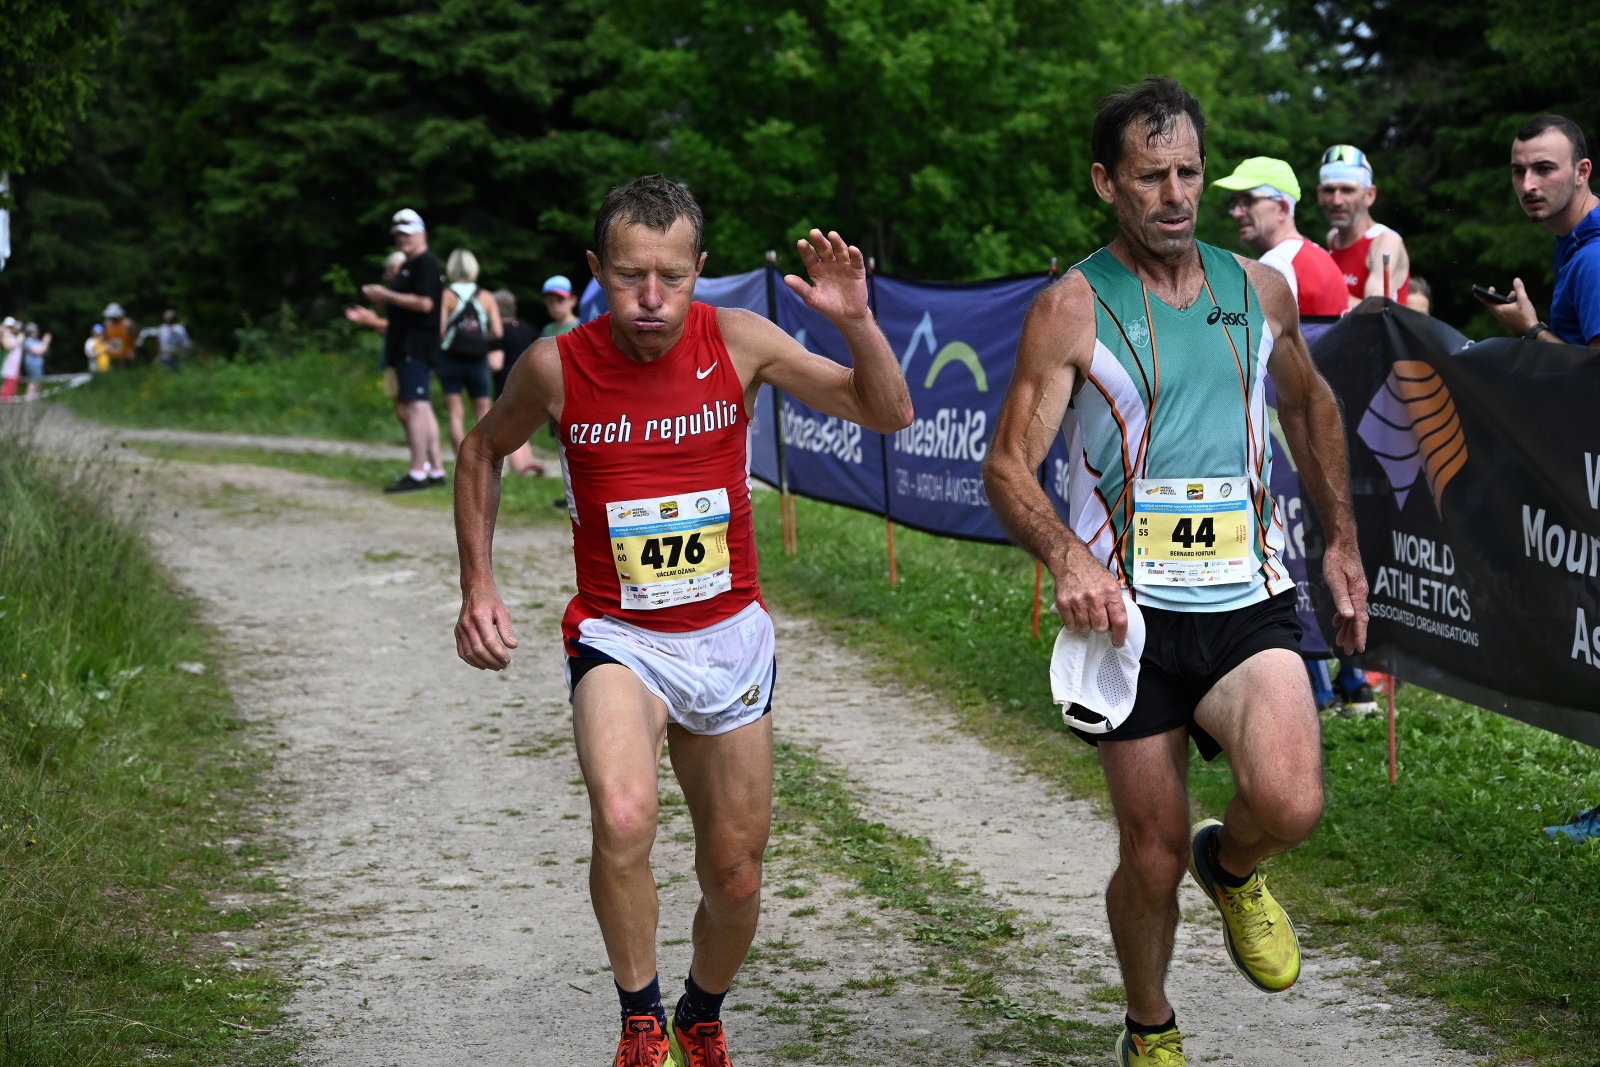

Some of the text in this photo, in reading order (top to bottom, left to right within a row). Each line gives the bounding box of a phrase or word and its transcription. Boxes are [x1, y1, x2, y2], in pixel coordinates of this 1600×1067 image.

[570, 400, 737, 444] czech republic
[616, 543, 624, 551] M
[1138, 528, 1149, 536] 55
[1171, 517, 1216, 548] 44
[617, 554, 627, 562] 60
[641, 533, 706, 569] 476
[1392, 529, 1455, 576] WORLD
[656, 567, 697, 578] VÁCLAV OŽANA
[1373, 565, 1471, 622] ATHLETICS
[1366, 602, 1480, 647] ASSOCIATED ORGANISATIONS
